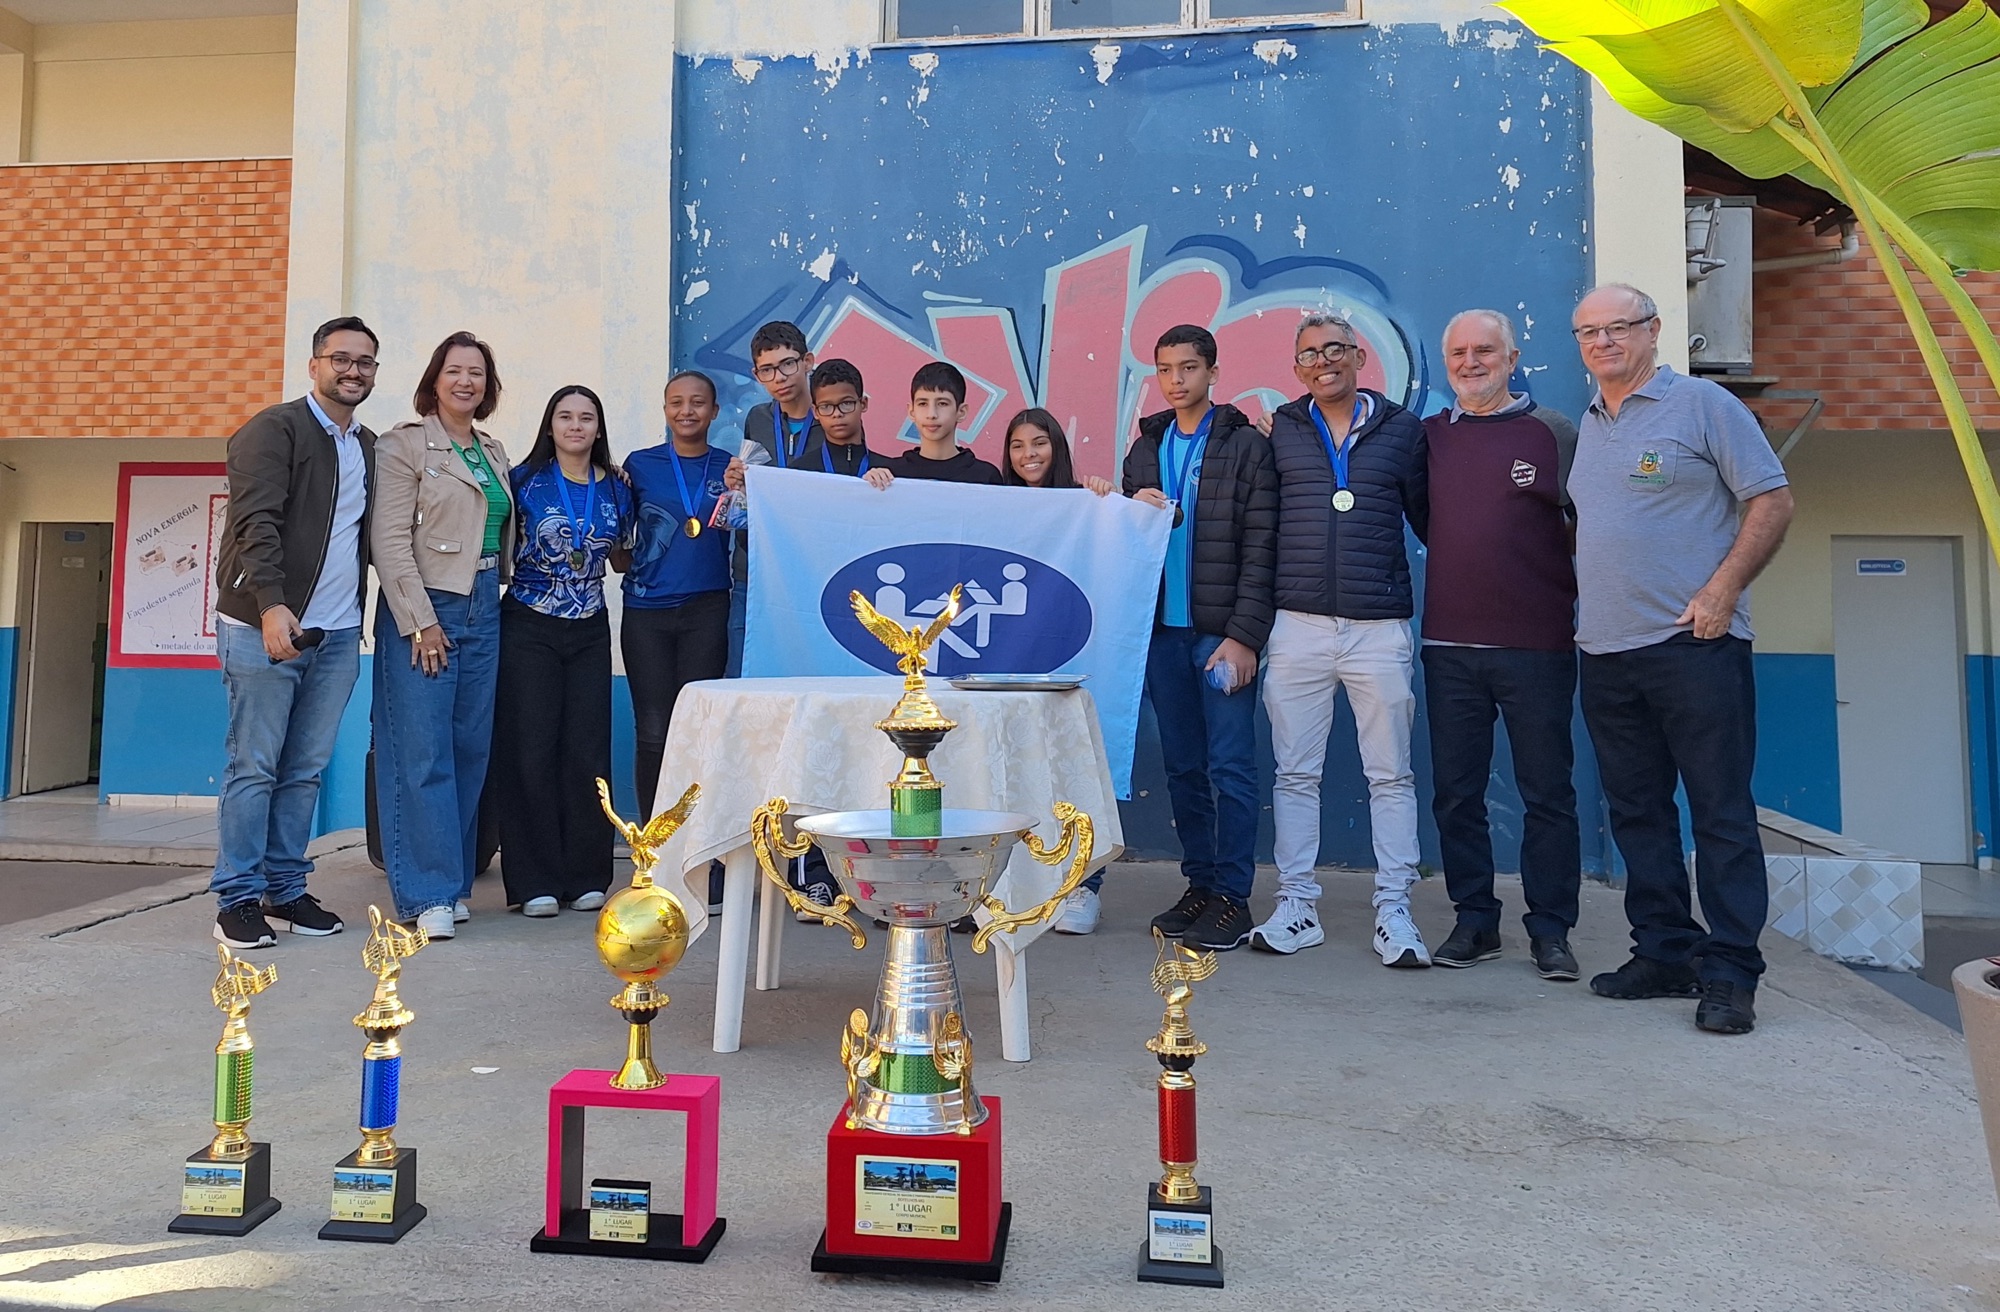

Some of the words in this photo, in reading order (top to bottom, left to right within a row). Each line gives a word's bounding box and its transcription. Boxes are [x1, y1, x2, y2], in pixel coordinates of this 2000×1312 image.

[135, 526, 161, 546] NOVA
[160, 503, 199, 530] ENERGIA
[146, 594, 168, 611] desta
[168, 577, 202, 597] segunda
[161, 641, 191, 650] metade
[193, 641, 205, 650] do
[903, 1203, 933, 1213] LUGAR
